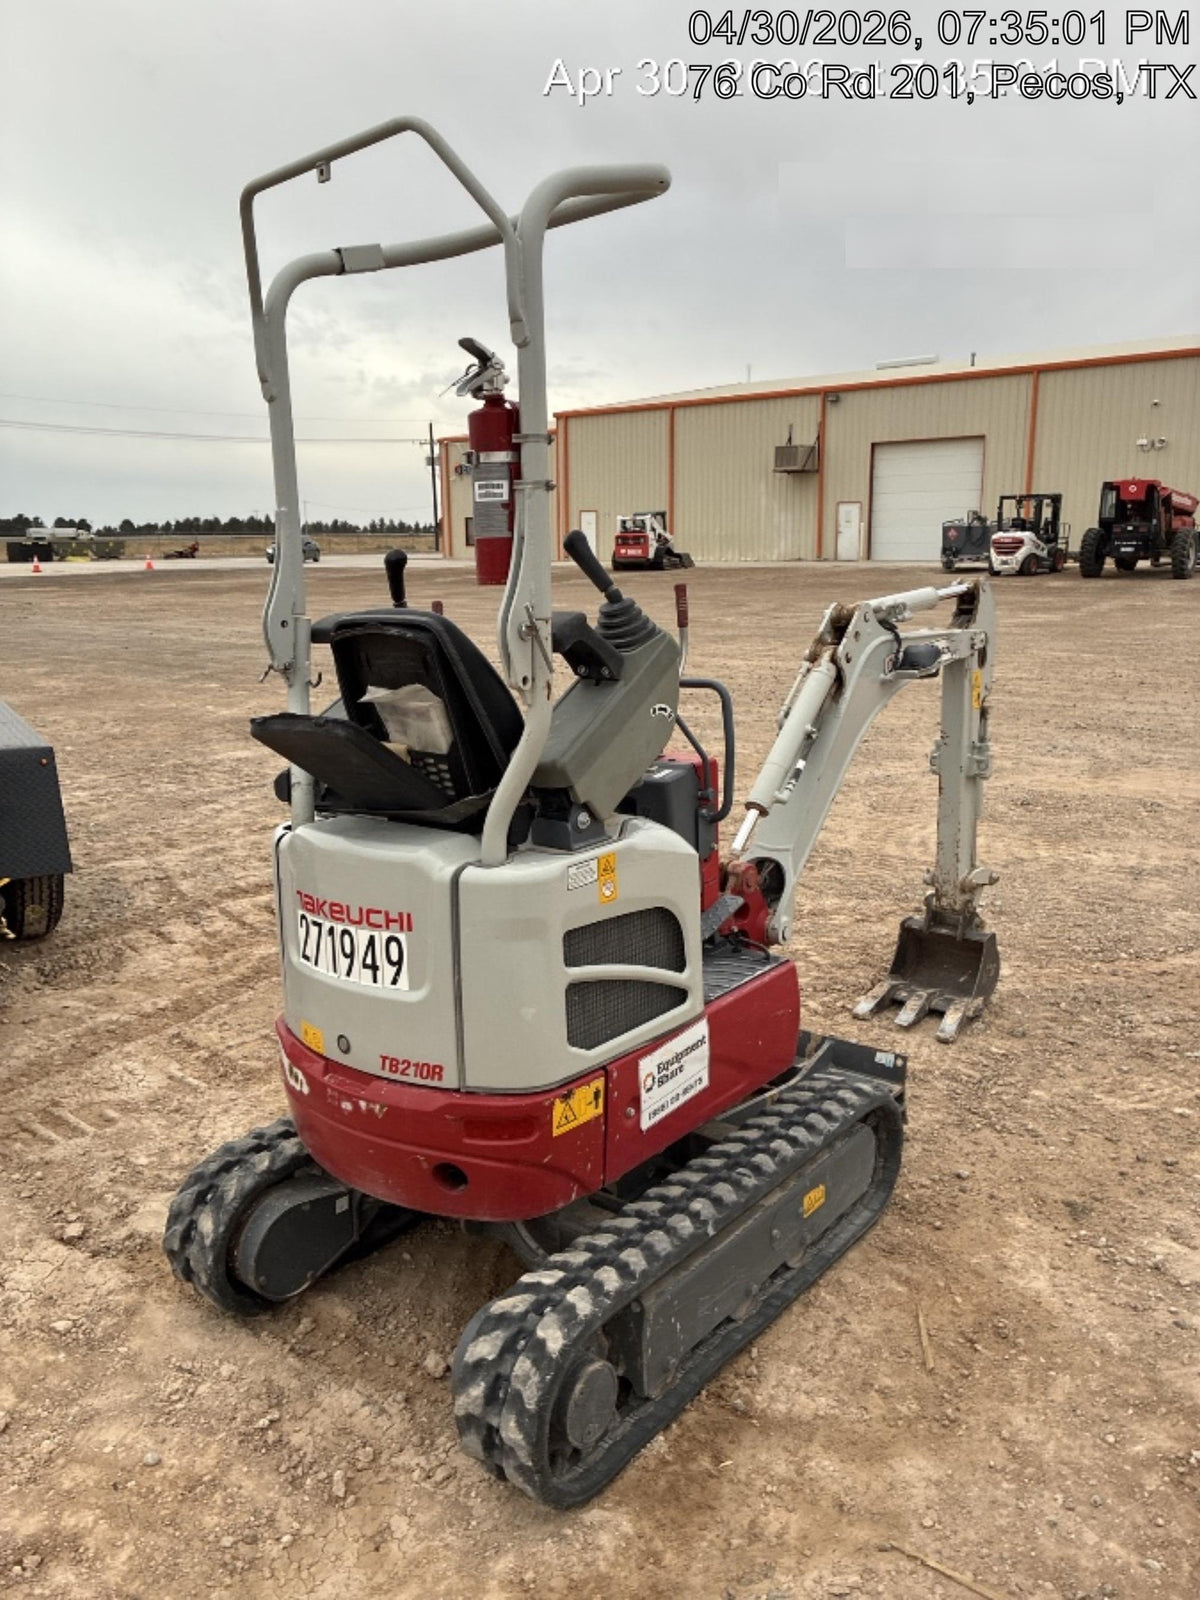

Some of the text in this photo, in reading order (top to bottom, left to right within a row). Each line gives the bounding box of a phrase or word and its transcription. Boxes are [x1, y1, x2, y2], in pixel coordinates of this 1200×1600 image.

[299, 913, 405, 987] 271949
[379, 1054, 444, 1082] TB210R
[656, 1034, 707, 1076] Equipment
[656, 1063, 685, 1089] Share
